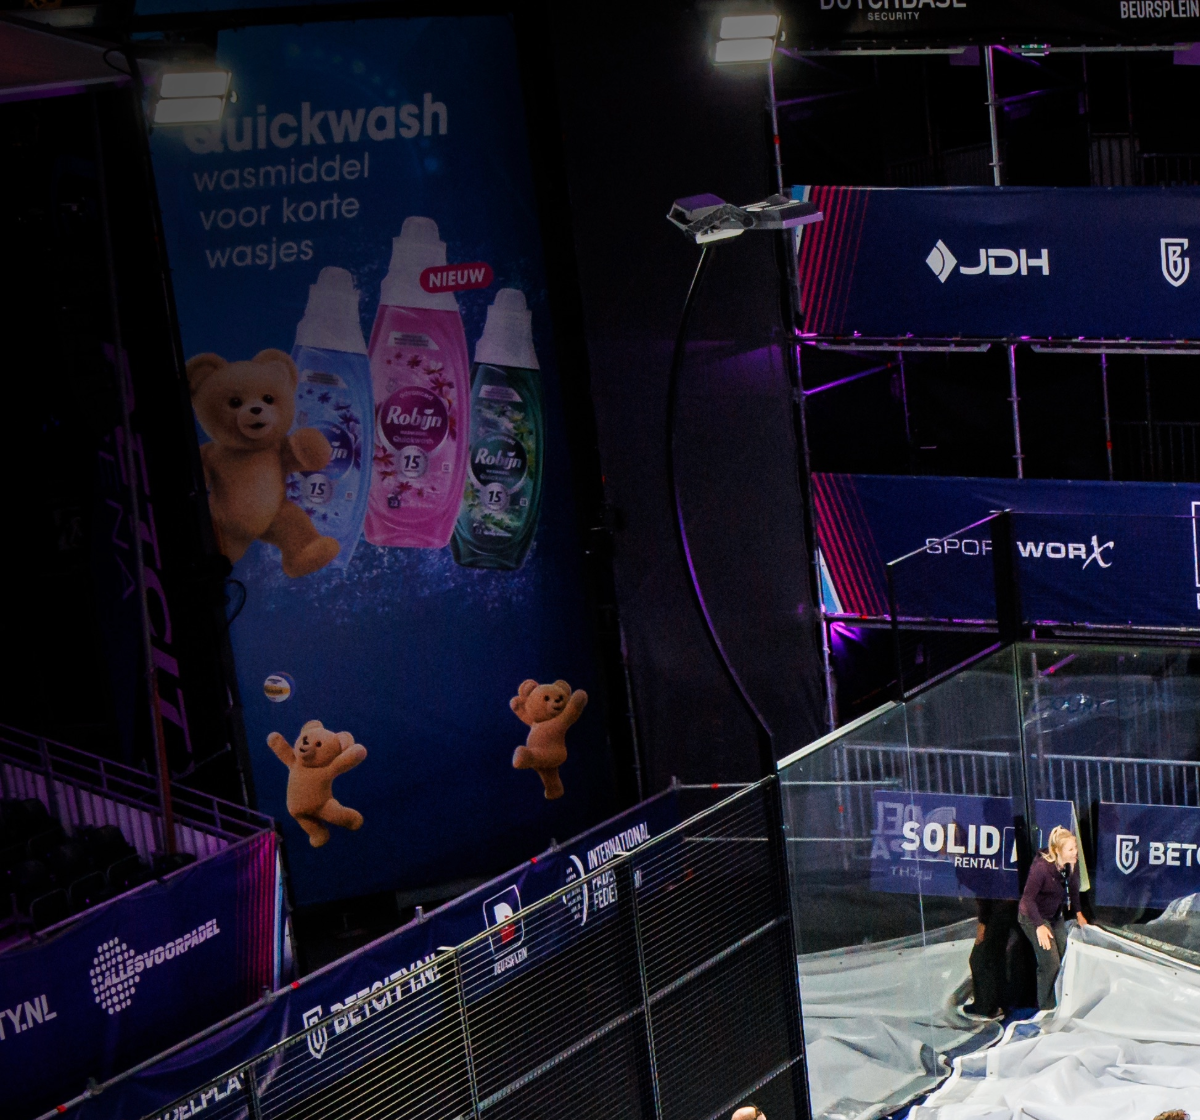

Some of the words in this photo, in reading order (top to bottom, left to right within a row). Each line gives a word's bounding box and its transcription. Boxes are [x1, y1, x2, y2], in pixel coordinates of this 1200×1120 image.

[867, 11, 920, 21] SECURITY
[1120, 0, 1200, 19] BEURSPLEIN
[193, 152, 370, 192] wasmiddel
[200, 205, 271, 231] voor
[282, 193, 360, 224] korte
[205, 237, 314, 271] wasjes
[959, 248, 1050, 276] JDH
[428, 267, 486, 289] NIEUW
[386, 406, 443, 430] Robijn
[404, 454, 421, 470] 15
[475, 448, 522, 469] Robijn
[310, 482, 326, 496] 15
[489, 491, 503, 503] 15
[901, 821, 1001, 856] SOLID
[954, 857, 1000, 870] RENTAL
[101, 918, 221, 991] ALLESVOORPADEL
